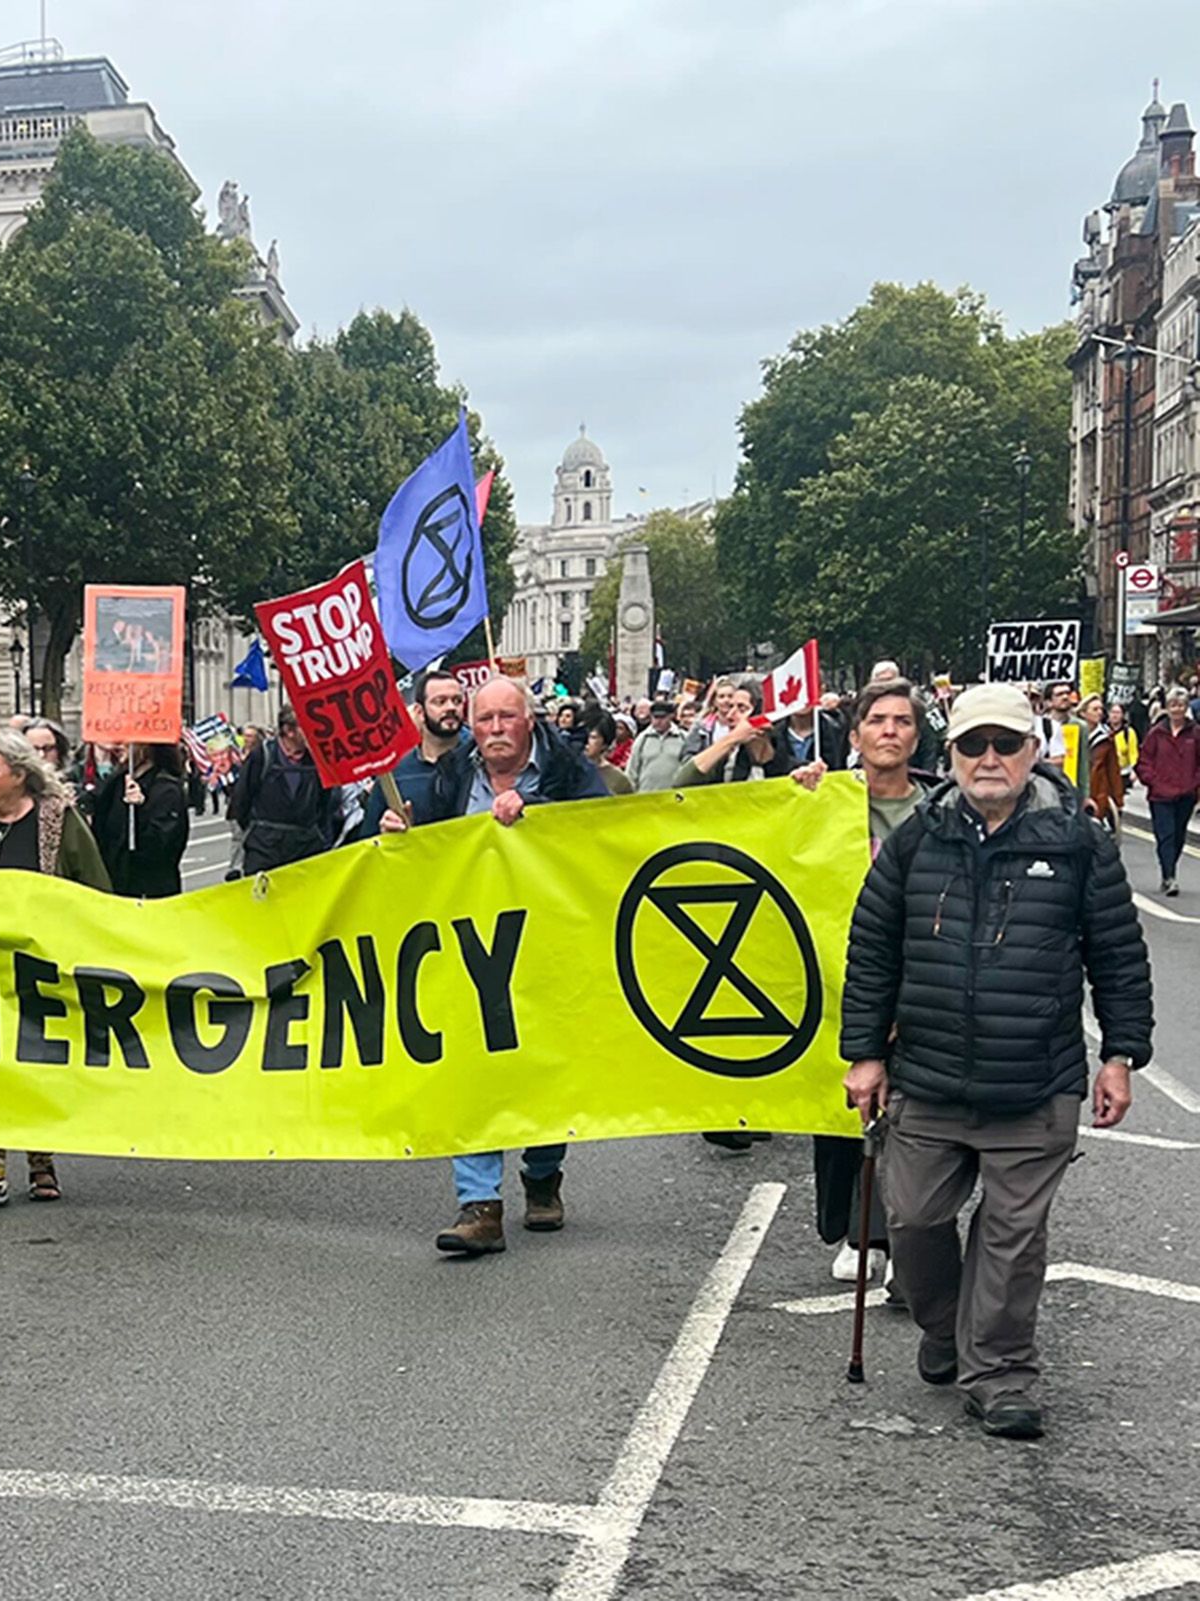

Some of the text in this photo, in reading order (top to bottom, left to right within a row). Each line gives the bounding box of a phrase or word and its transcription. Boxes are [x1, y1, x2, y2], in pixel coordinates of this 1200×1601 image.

[271, 582, 362, 655] STOP
[1062, 624, 1076, 651] A
[284, 622, 374, 687] TRUMP
[457, 665, 495, 688] STO
[989, 652, 1074, 682] WANKER
[305, 669, 389, 739] STOP
